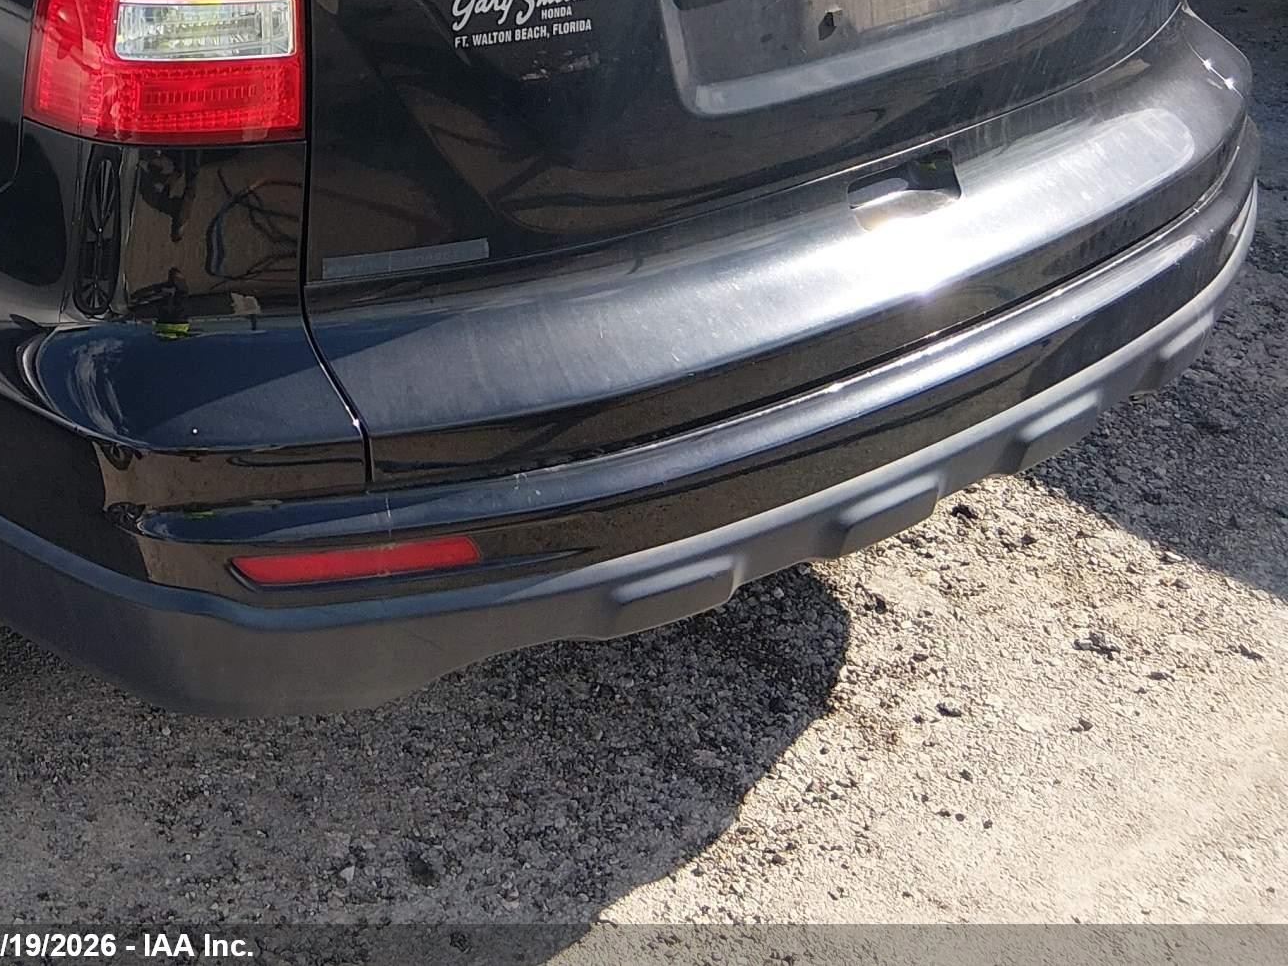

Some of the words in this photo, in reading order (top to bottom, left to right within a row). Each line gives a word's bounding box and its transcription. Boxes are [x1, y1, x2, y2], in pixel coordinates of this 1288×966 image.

[541, 5, 573, 20] HONDA
[454, 35, 470, 49] FT.
[472, 30, 512, 47] WALTON
[514, 24, 550, 42] BEACH,
[552, 18, 592, 36] FLORIDA
